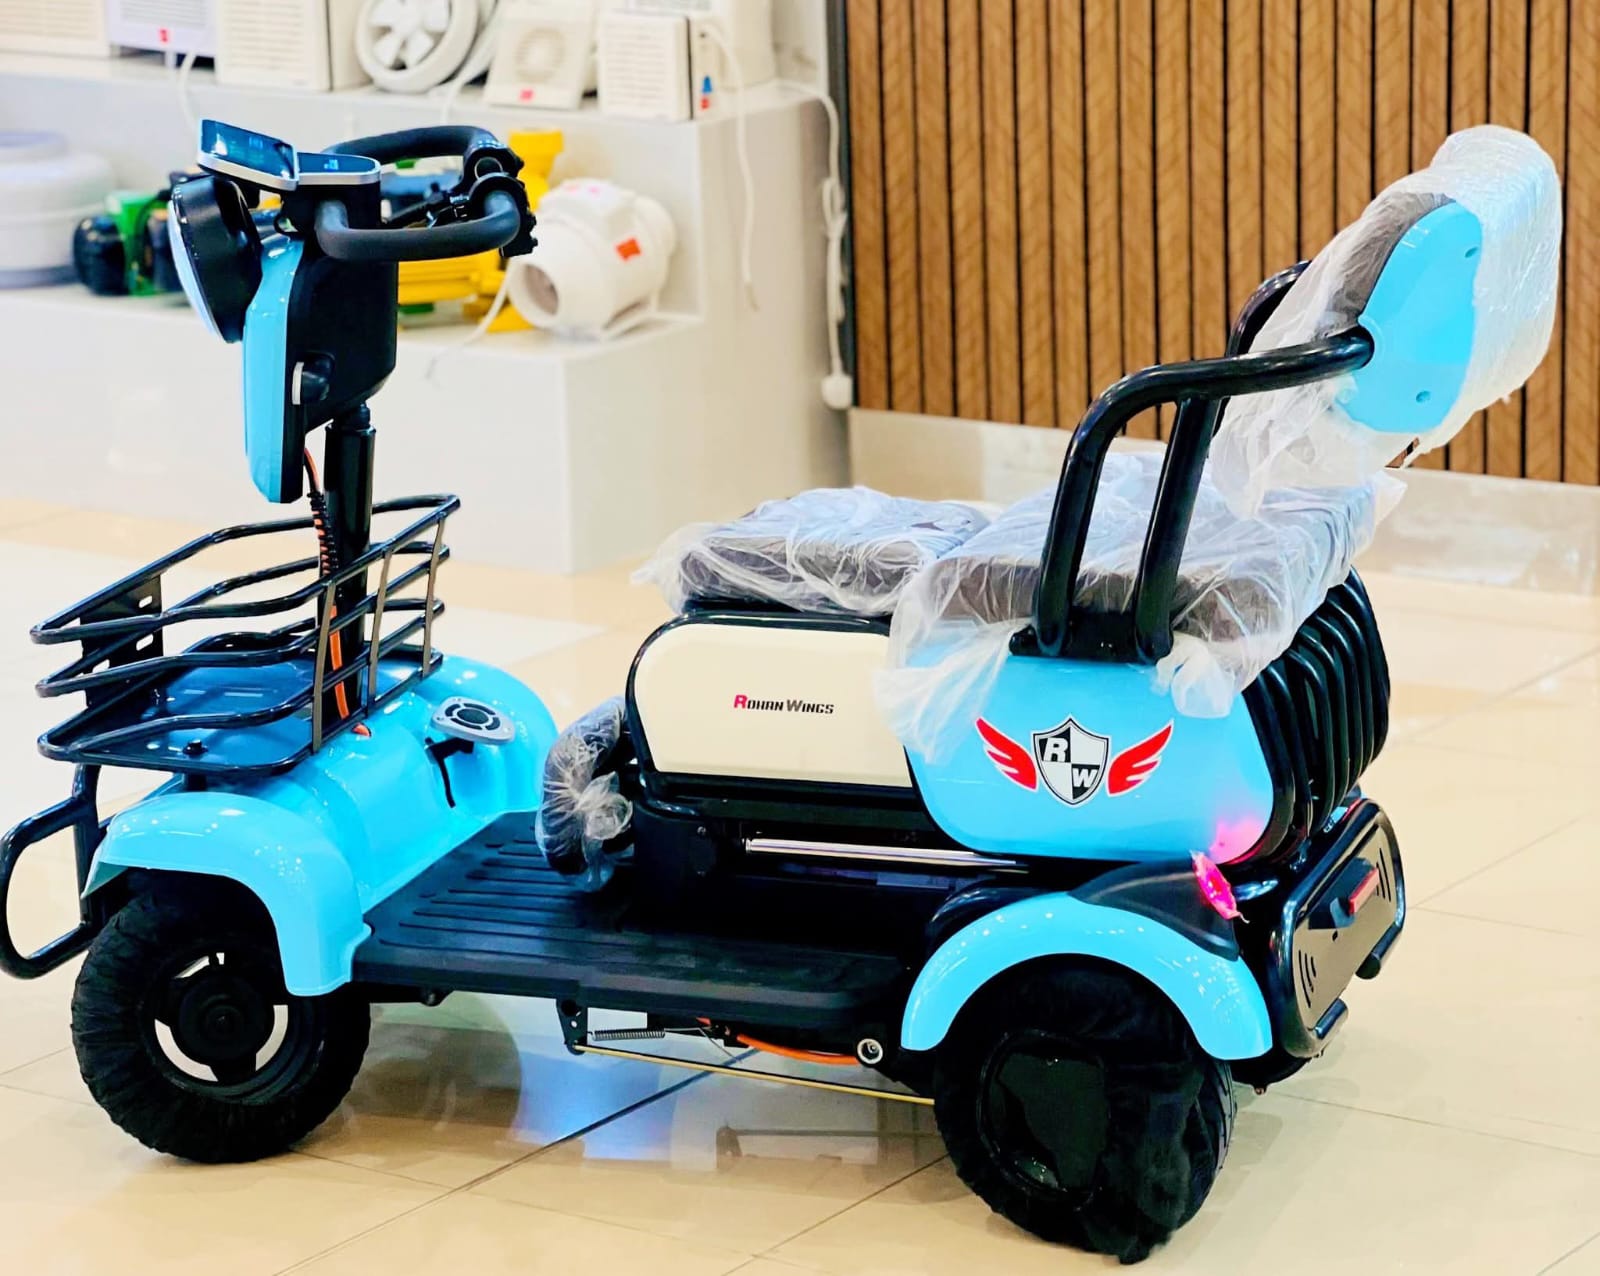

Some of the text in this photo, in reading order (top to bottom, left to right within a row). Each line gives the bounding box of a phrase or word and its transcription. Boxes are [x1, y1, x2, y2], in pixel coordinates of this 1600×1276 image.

[733, 694, 835, 714] ROHAN WINGS
[1043, 737, 1069, 762] R
[1072, 767, 1099, 788] W
